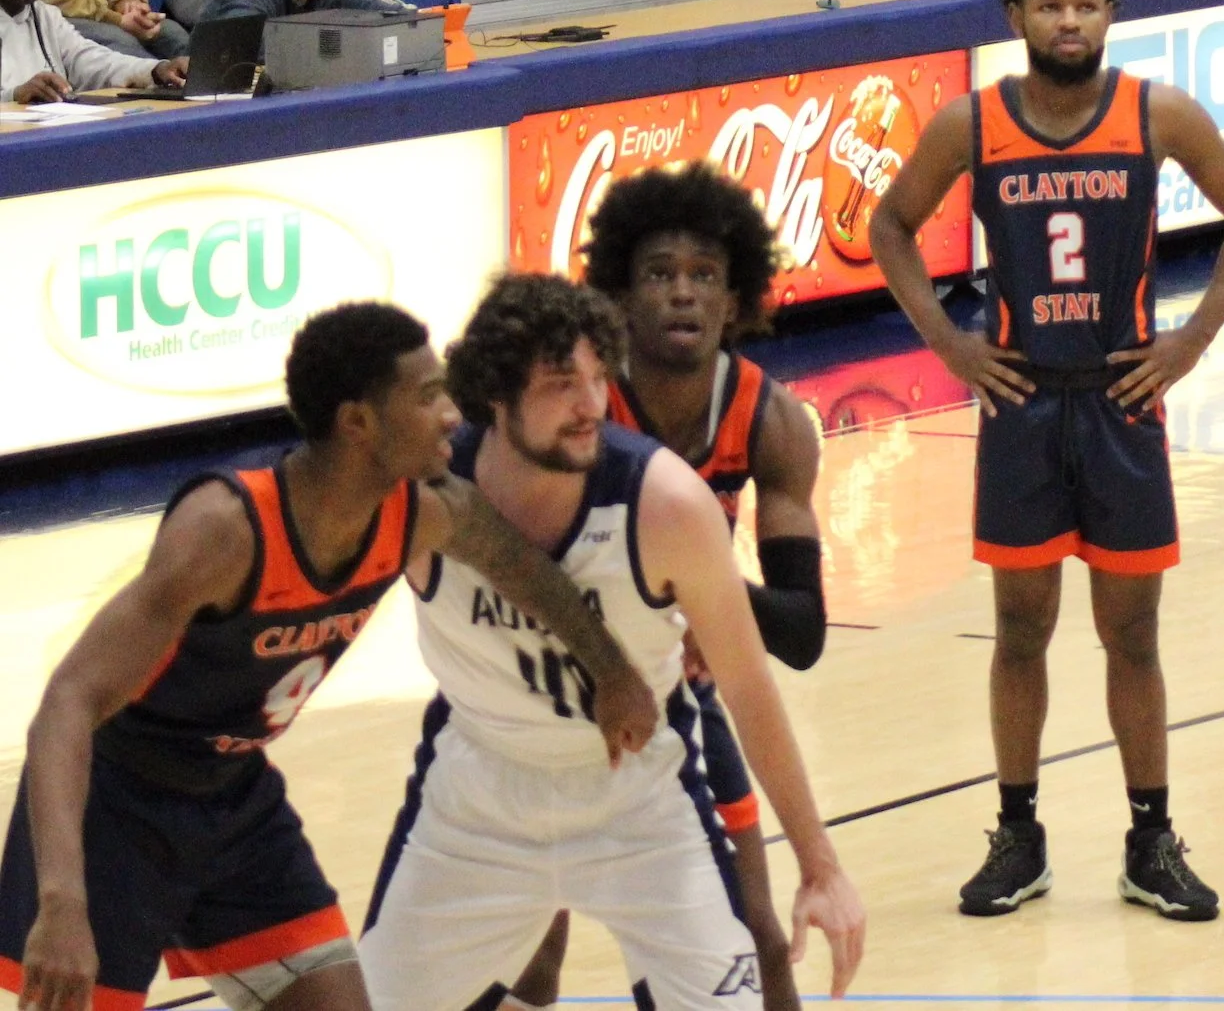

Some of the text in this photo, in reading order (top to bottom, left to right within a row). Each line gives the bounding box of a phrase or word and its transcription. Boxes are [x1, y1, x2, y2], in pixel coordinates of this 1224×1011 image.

[619, 118, 685, 162] Enjoy!
[999, 169, 1128, 205] CLAYTON
[1046, 211, 1086, 284] 2
[79, 210, 301, 339] HCCU
[129, 333, 183, 362] Health
[189, 327, 244, 352] Center
